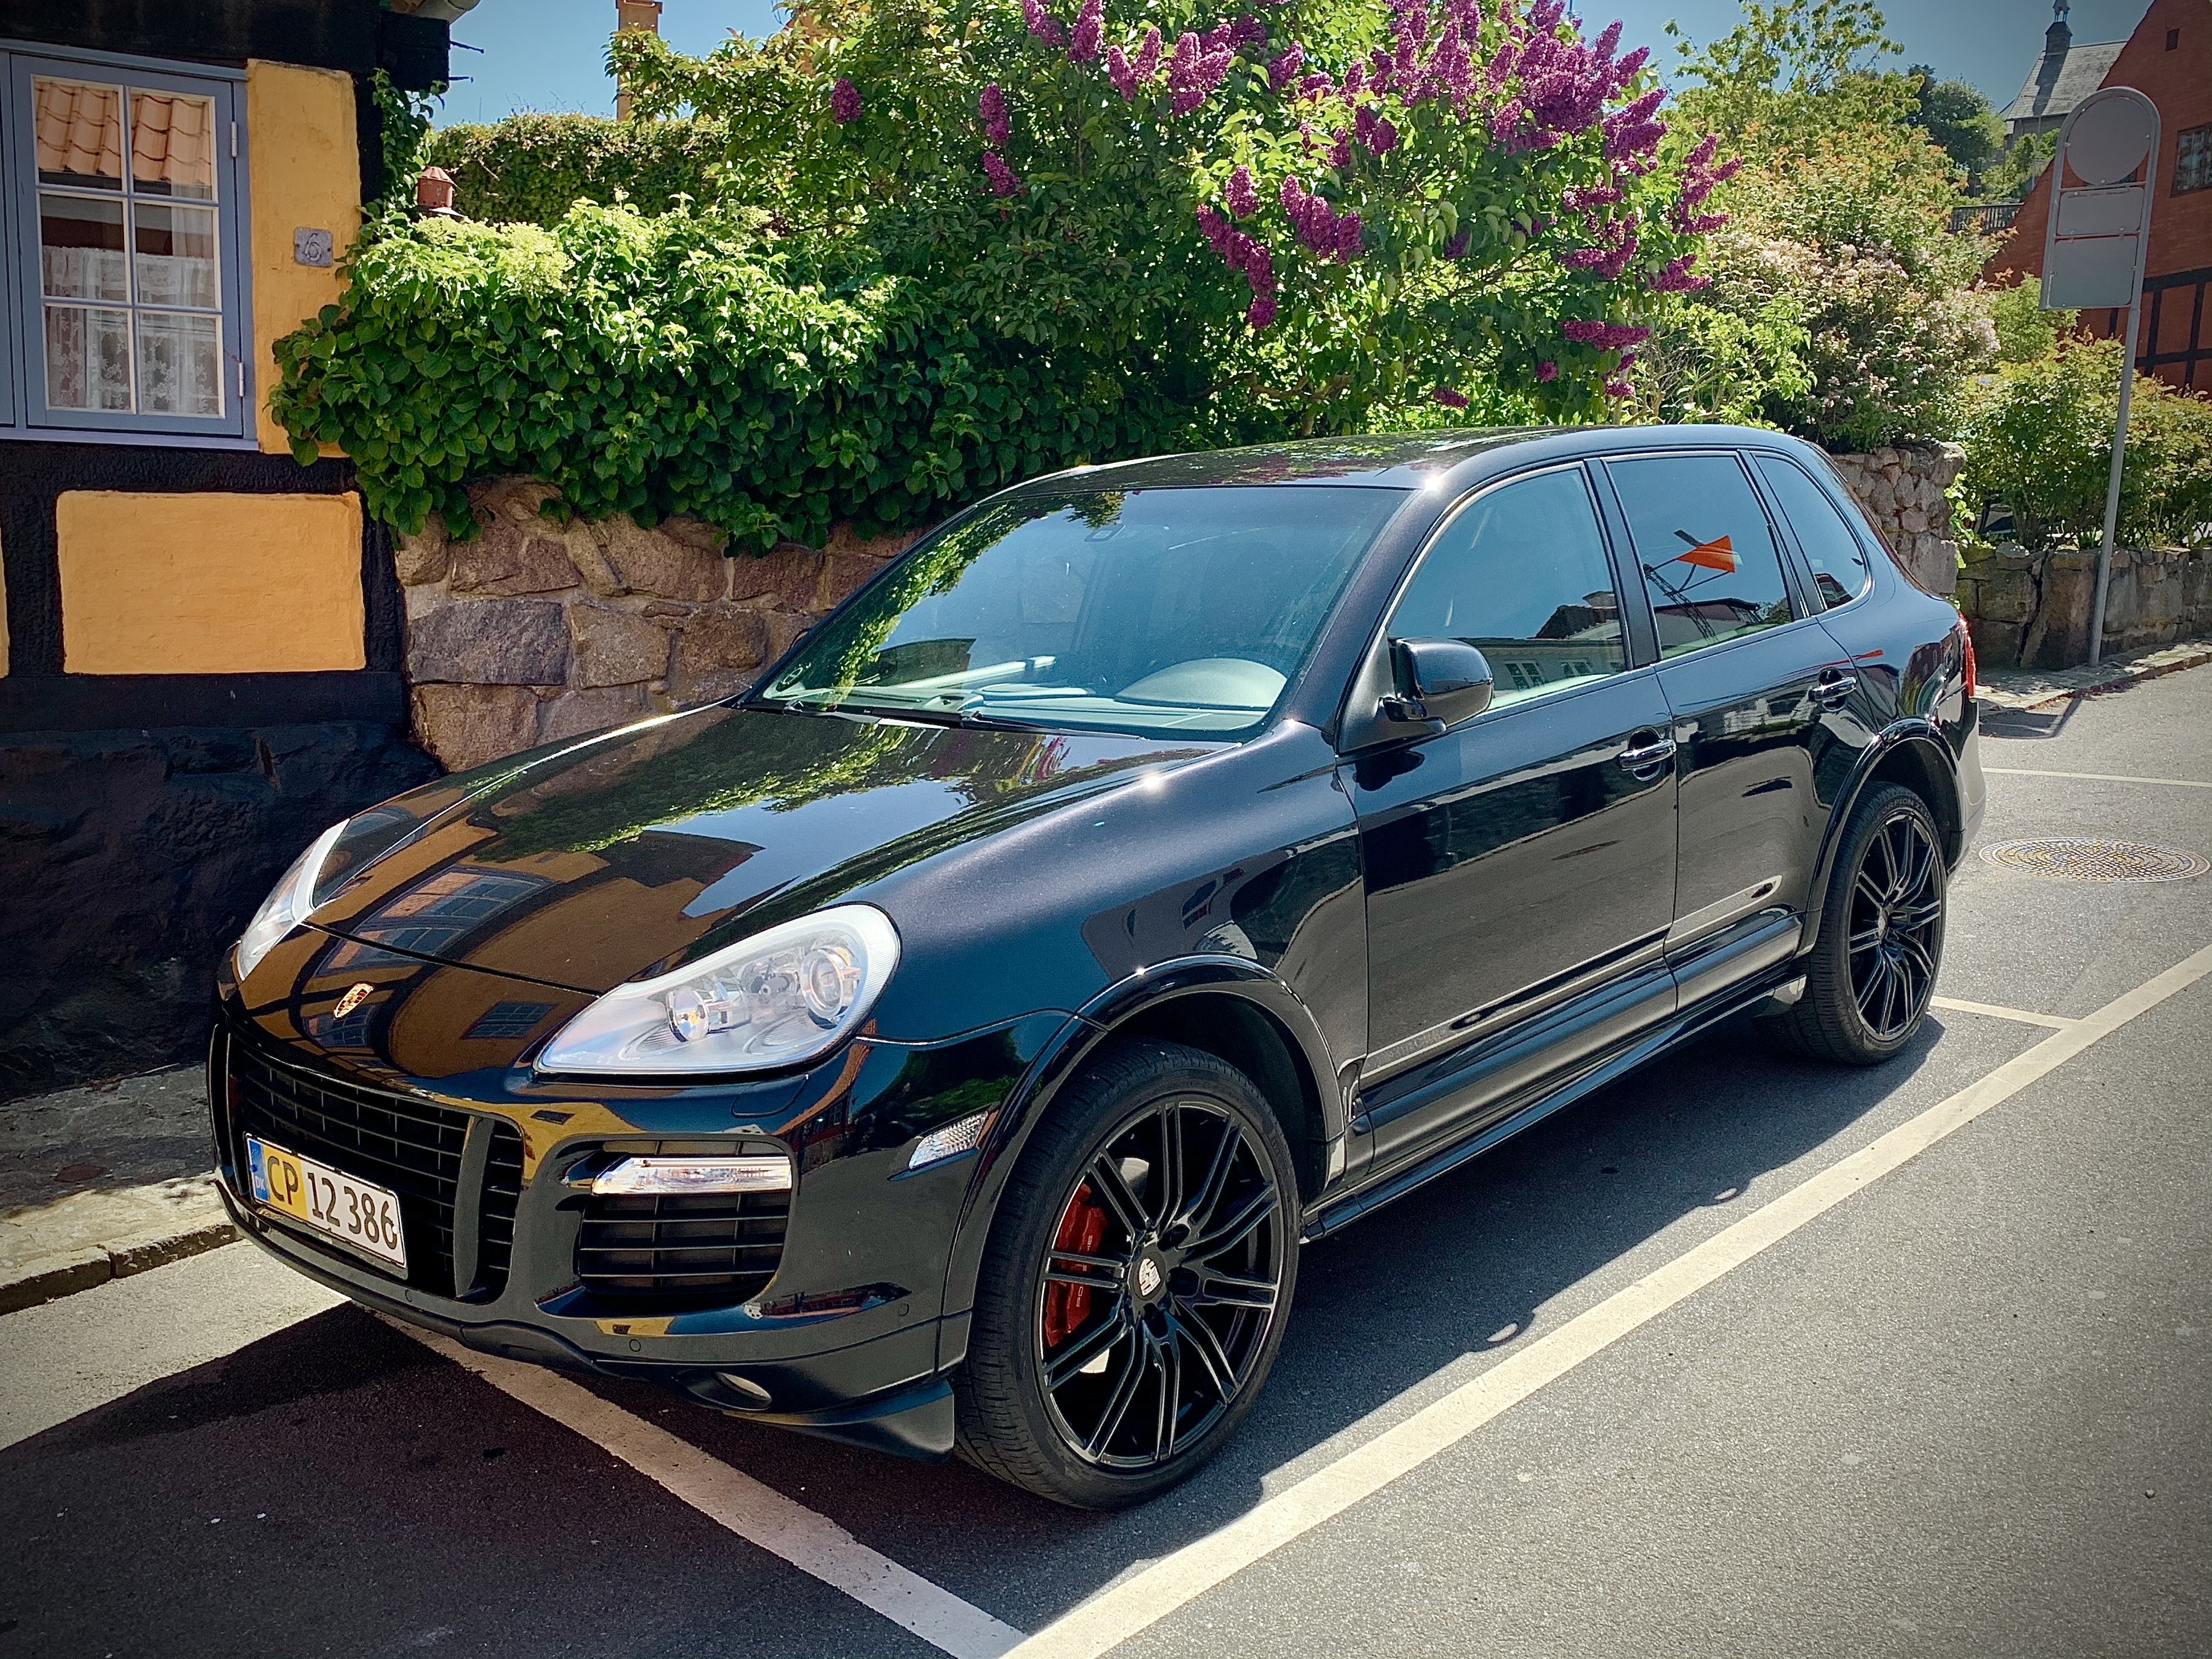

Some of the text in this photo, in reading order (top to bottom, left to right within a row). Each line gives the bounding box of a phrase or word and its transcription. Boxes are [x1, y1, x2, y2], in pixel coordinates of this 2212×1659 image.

[304, 233, 322, 262] 6
[255, 1175, 266, 1192] DK
[267, 1155, 397, 1250] CP 12 386
